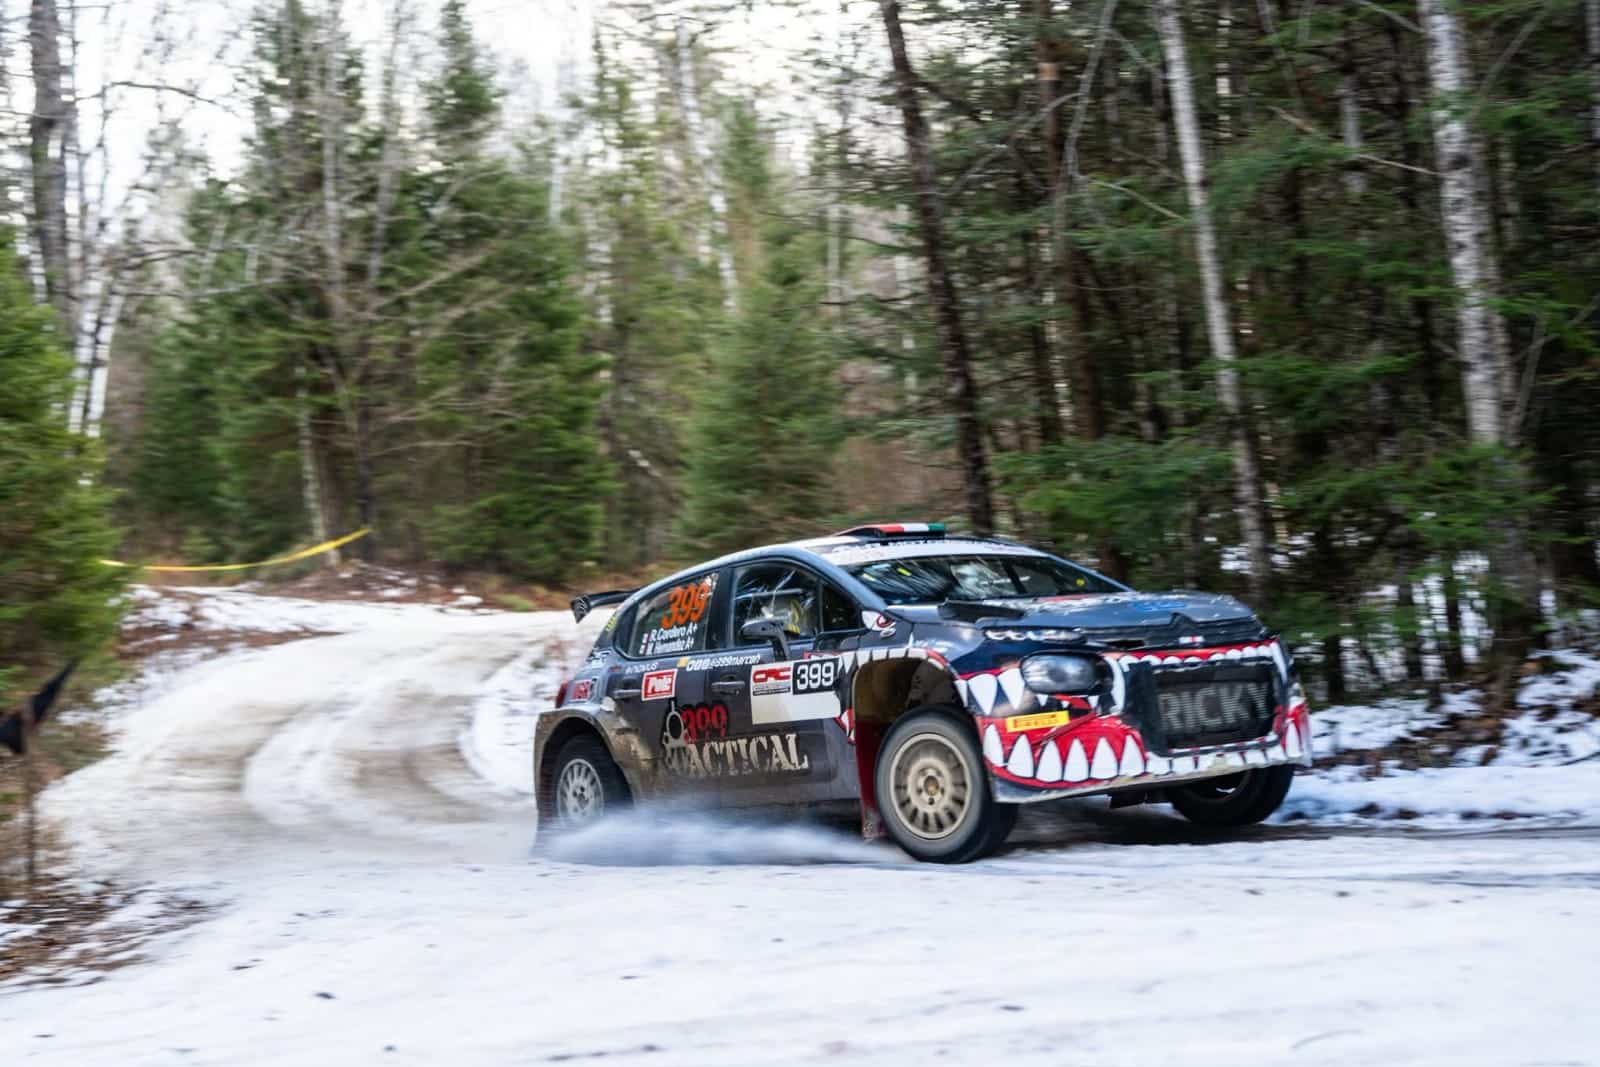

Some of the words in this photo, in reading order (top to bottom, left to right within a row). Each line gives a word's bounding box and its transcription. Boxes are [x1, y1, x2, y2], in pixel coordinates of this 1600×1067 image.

[661, 582, 710, 630] 399
[796, 661, 834, 690] 399
[1157, 682, 1270, 733] RICKY
